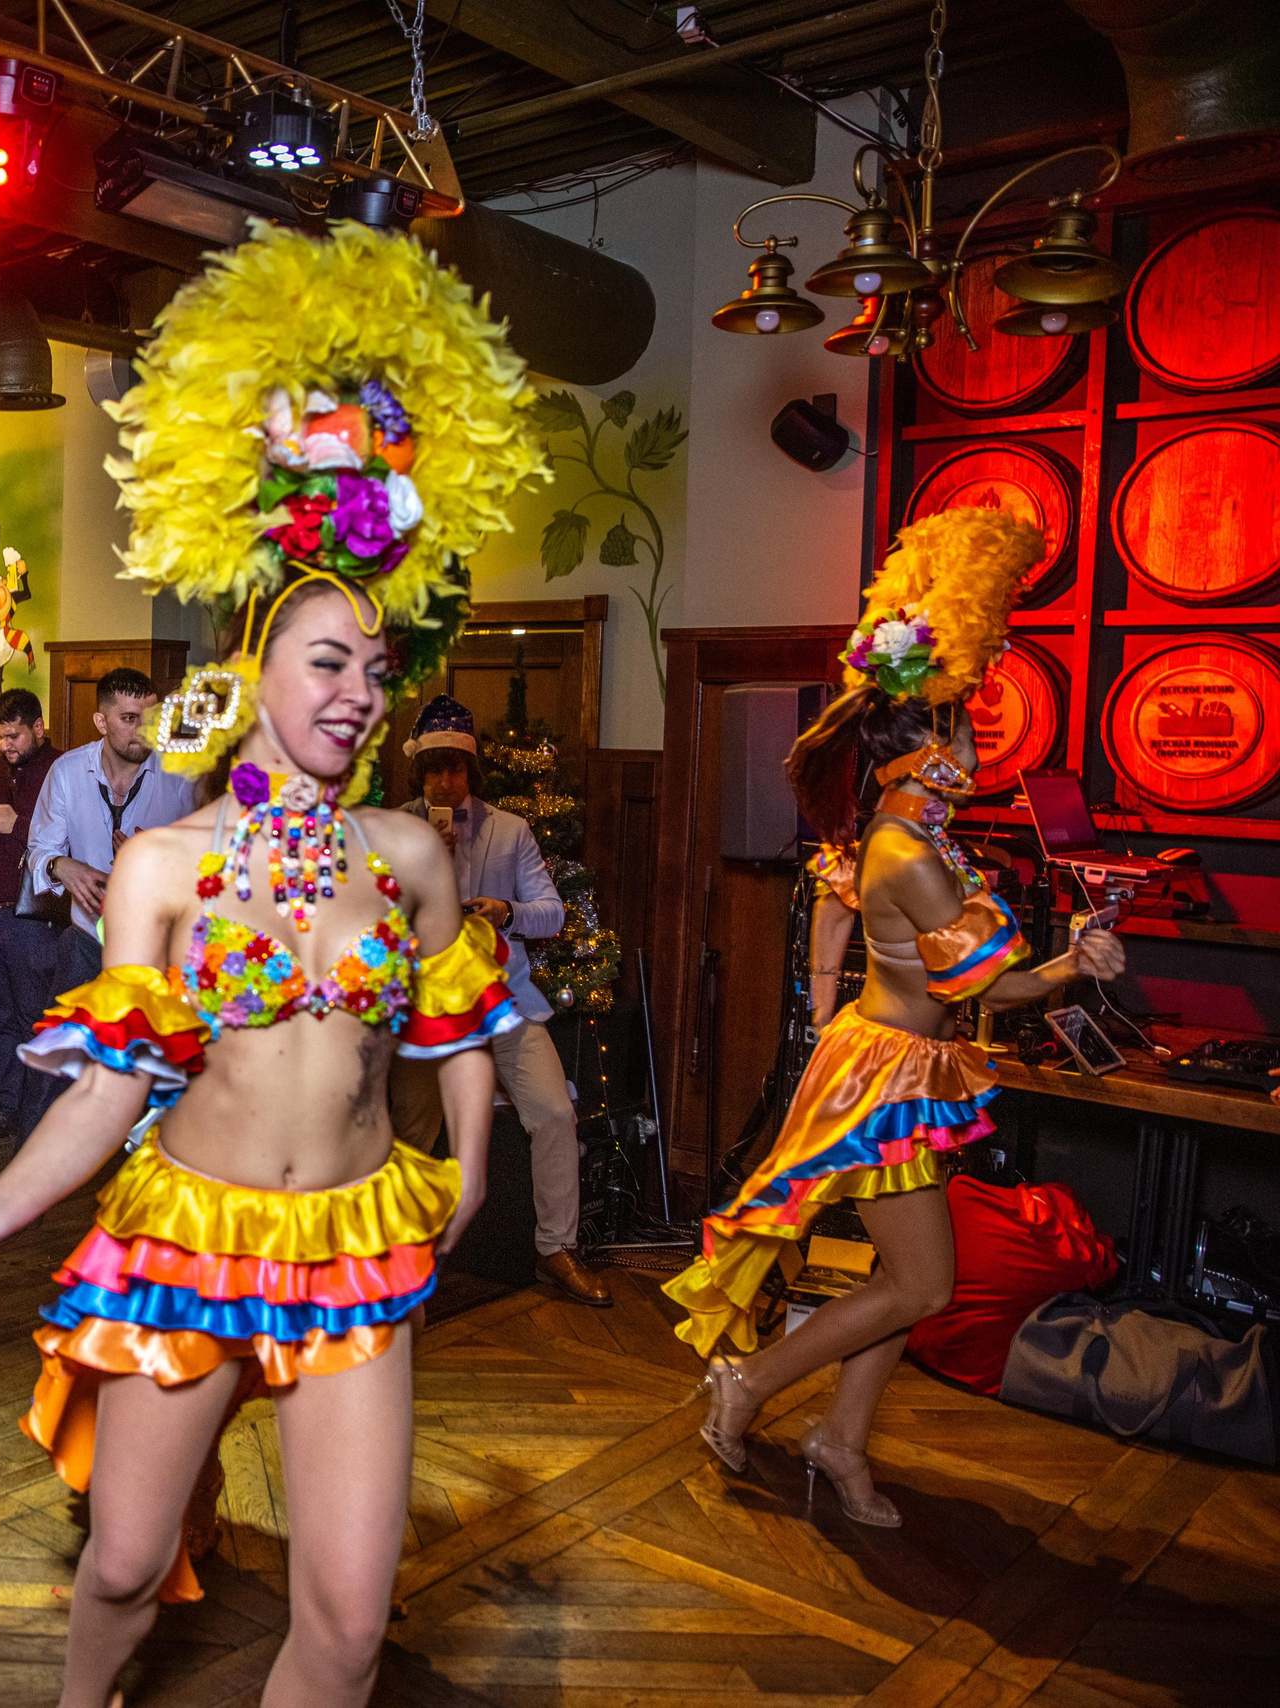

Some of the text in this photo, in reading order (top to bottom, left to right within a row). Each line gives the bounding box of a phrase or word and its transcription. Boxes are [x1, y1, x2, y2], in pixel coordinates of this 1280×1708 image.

[1160, 685, 1235, 696] ДЕТСКОЕ МЕНЮ
[1150, 740, 1239, 750] ДЕТСКАЯ КОМНАТА
[1156, 750, 1231, 760] (ВОСКРЕСЕНЬЕ)
